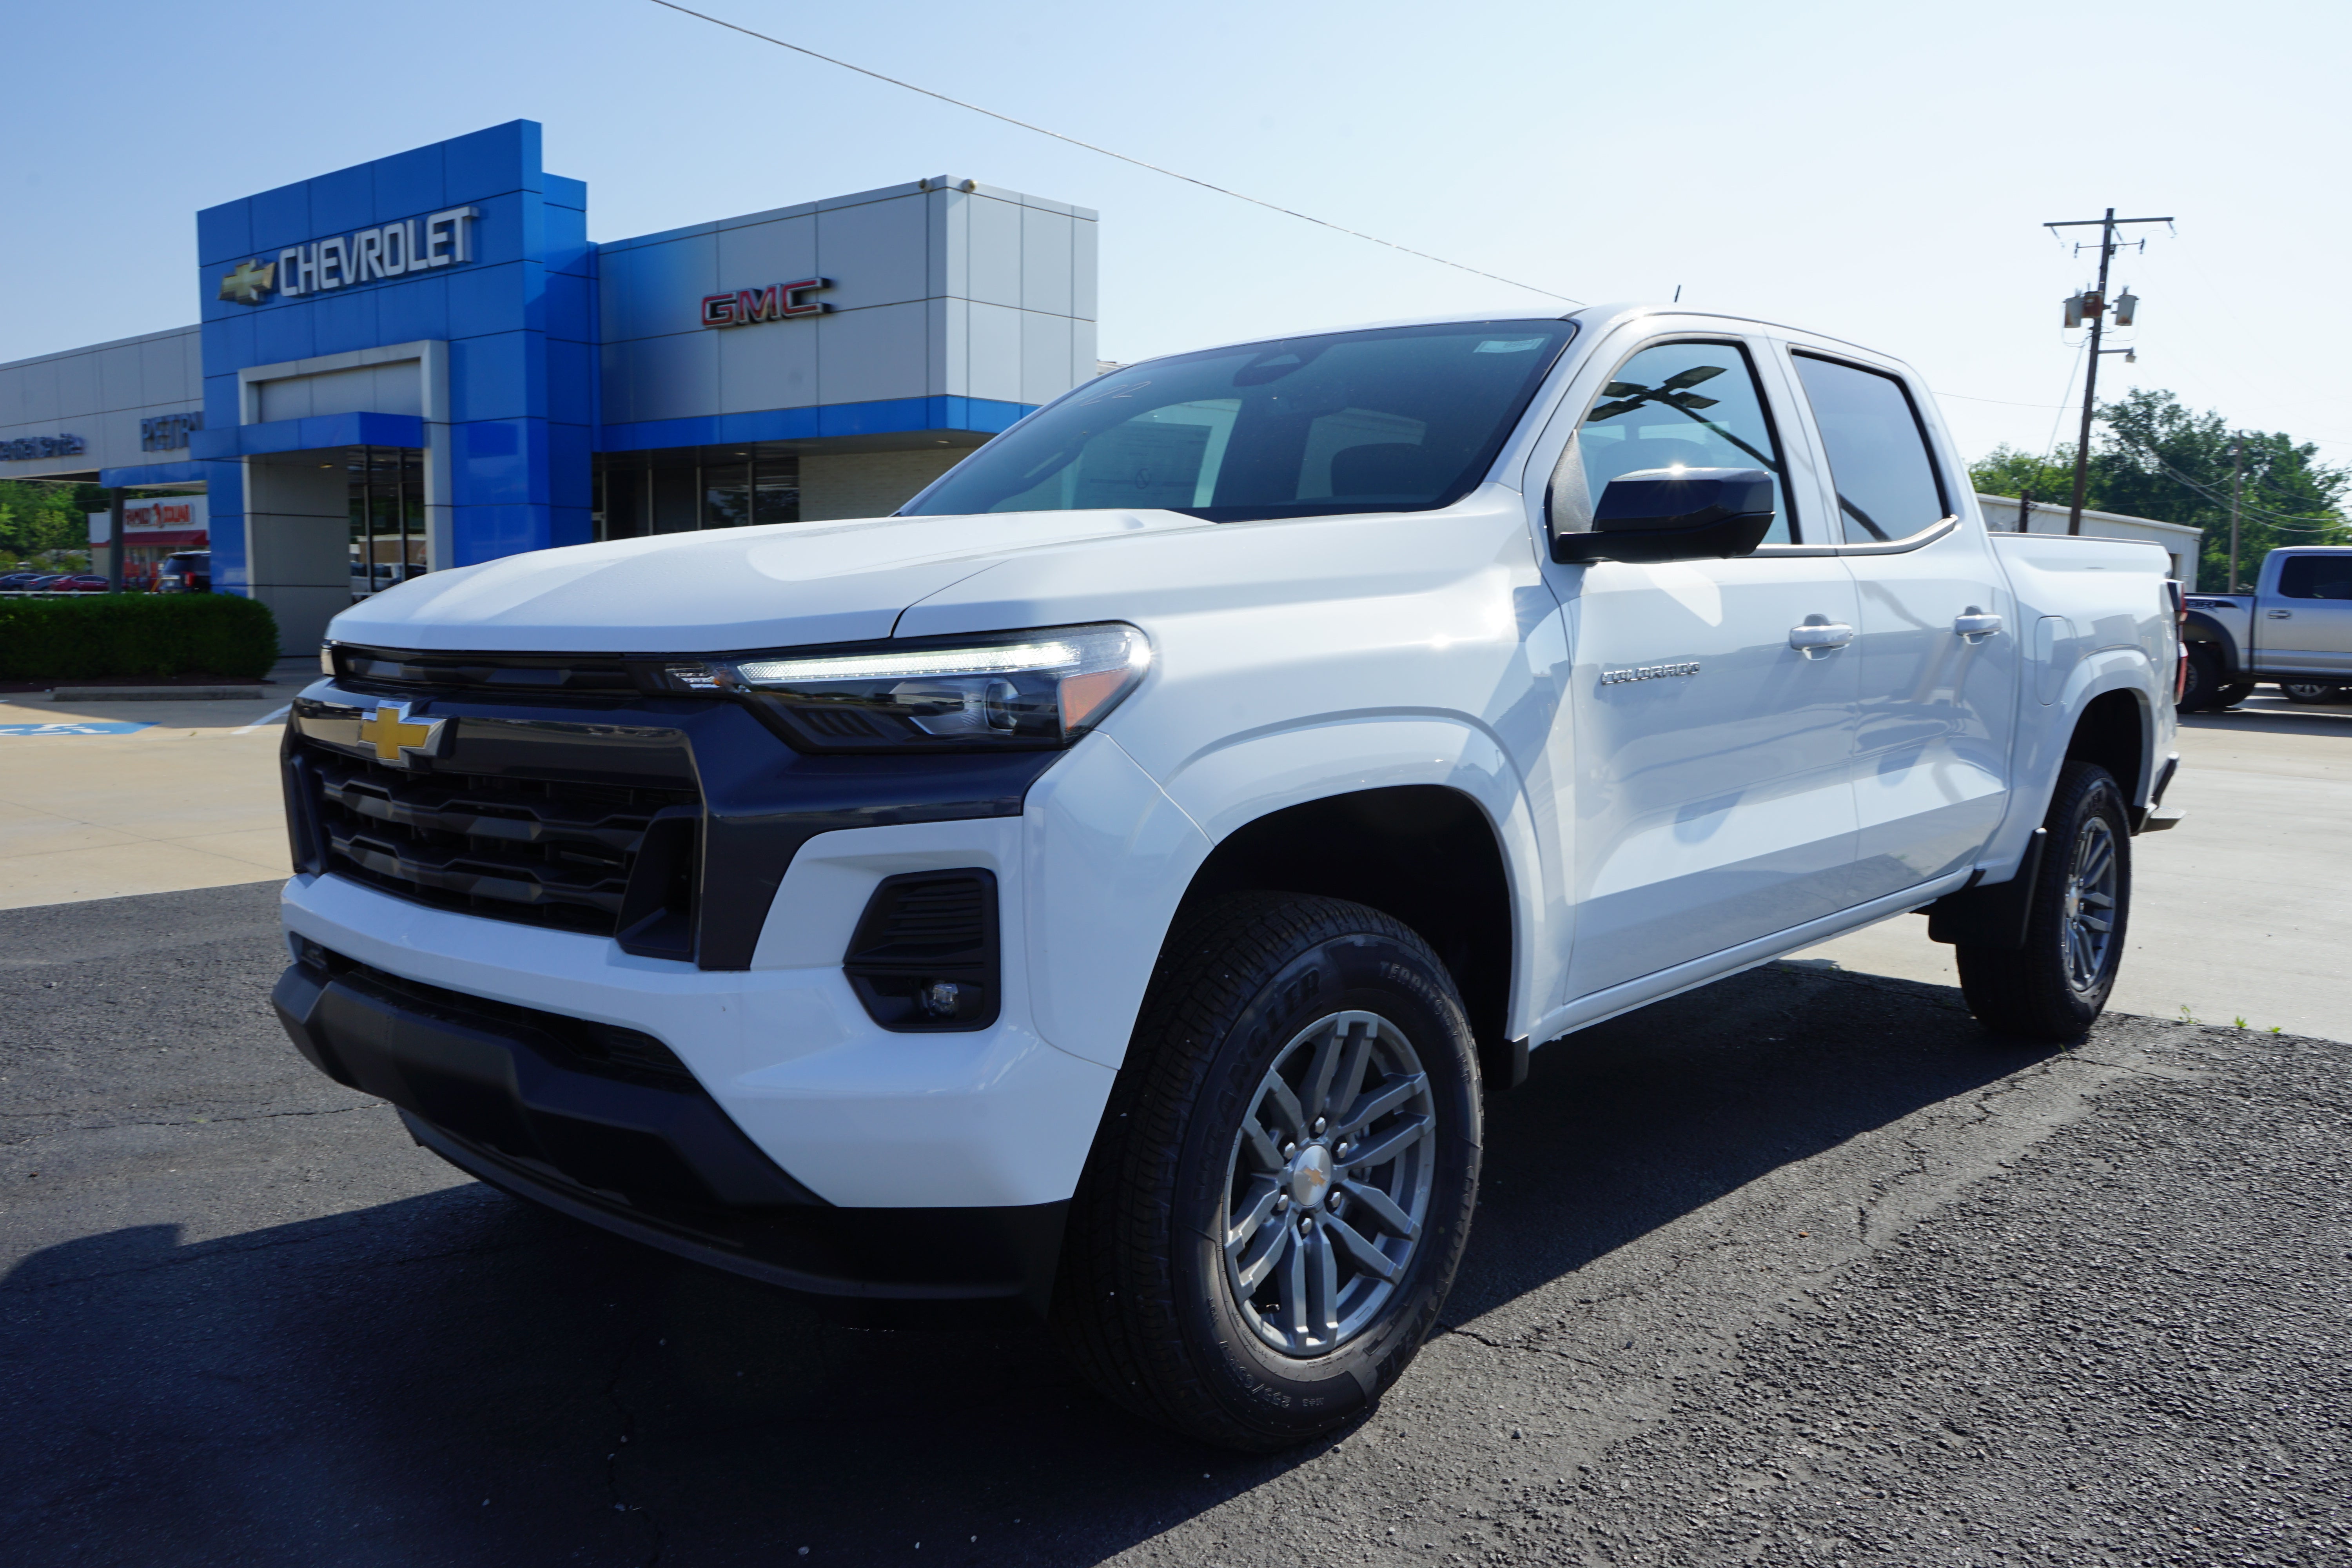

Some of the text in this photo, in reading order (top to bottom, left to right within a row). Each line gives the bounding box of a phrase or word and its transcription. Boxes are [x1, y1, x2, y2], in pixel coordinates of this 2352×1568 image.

[279, 206, 477, 297] CHEVROLET
[701, 277, 833, 329] GMC
[1601, 662, 1700, 685] COLORADO
